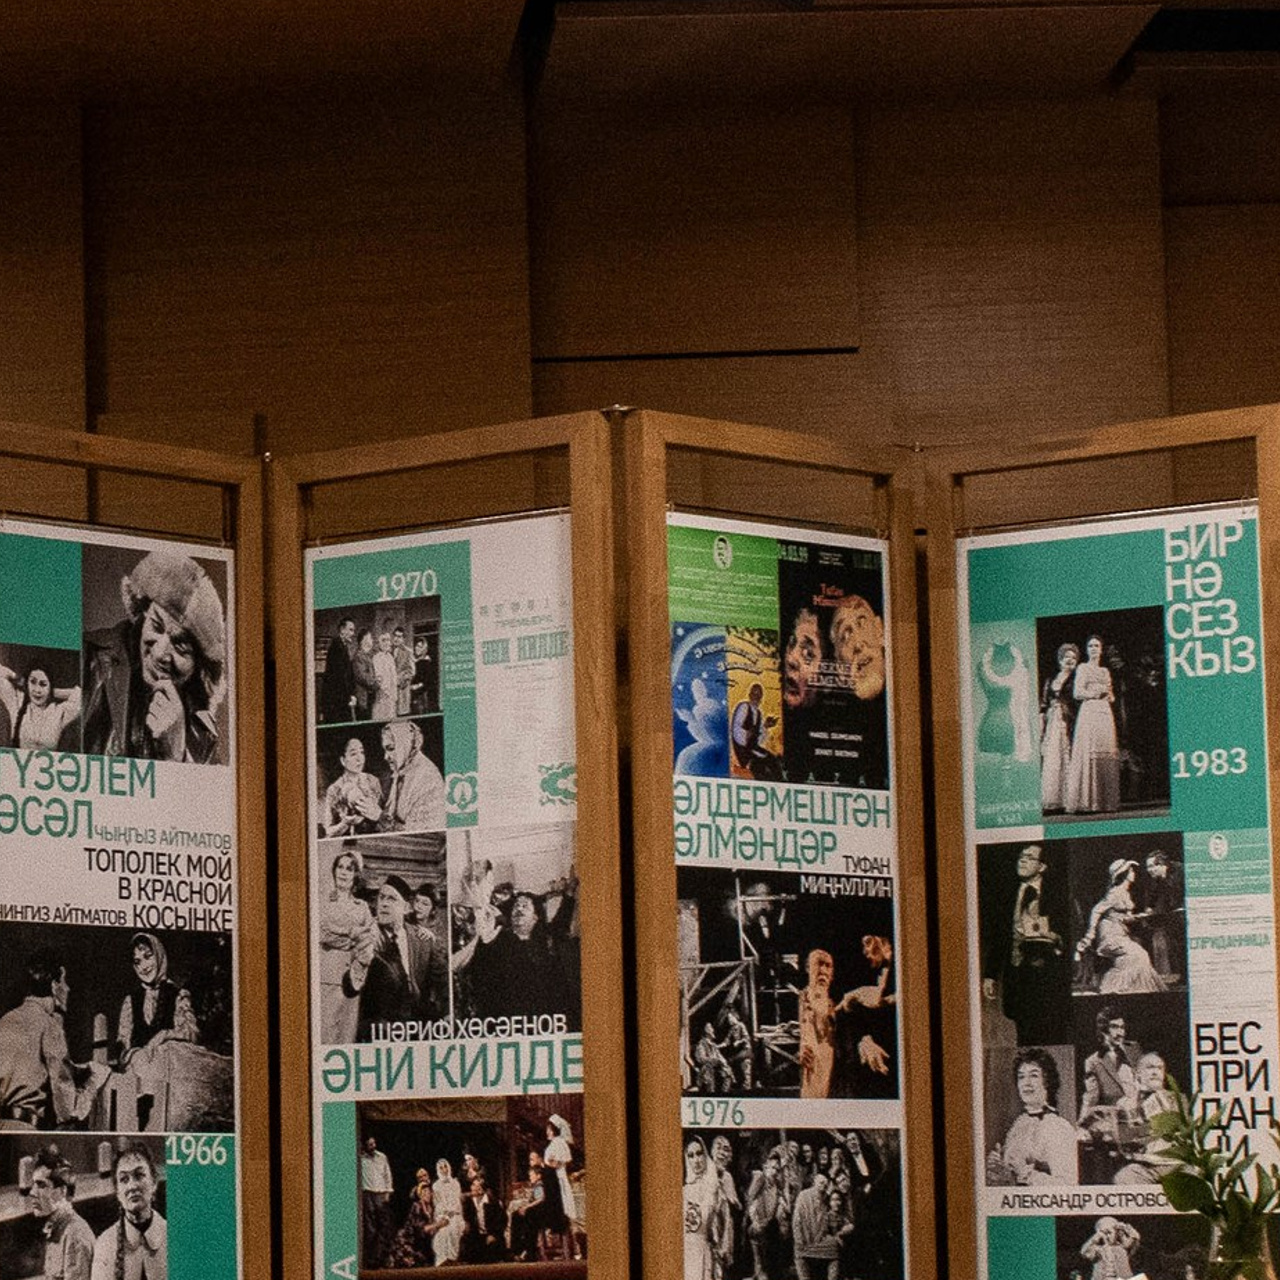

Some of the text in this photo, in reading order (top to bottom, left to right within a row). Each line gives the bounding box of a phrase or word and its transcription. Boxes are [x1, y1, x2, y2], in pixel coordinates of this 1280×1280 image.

[1164, 520, 1243, 563] БИР
[377, 569, 438, 601] 1970
[1166, 561, 1222, 601] НӘ
[1167, 598, 1239, 639] СЕЗ
[1170, 636, 1256, 678] КЫЗ
[1172, 748, 1247, 778] 1983
[674, 780, 890, 828] ӘЛДЕРМЕШТӘН
[94, 825, 157, 846] ЧЫҢГЫЗ
[159, 827, 232, 850] АЙТМАТОВ
[675, 822, 890, 874] ӘЛМӘНДӘР ТУФАН
[83, 847, 232, 879] ТОПОЛЕК МОЙ
[118, 875, 233, 906] В КРАСНОЙ
[52, 903, 128, 926] АЙТМАТОВ
[132, 904, 233, 933] КОСЫНКЕ
[371, 1014, 567, 1042] ШӘРИФ ХӨСӘЕНОВ
[1195, 1021, 1263, 1056] БЕС
[323, 1039, 584, 1094] ӘНИ КИЛДЕ
[1197, 1059, 1269, 1093] ПРИ
[687, 1100, 745, 1126] 1976
[165, 1135, 227, 1165] 1966
[1001, 1192, 1169, 1210] АЛЕКСАНДР ОСТРОВС
